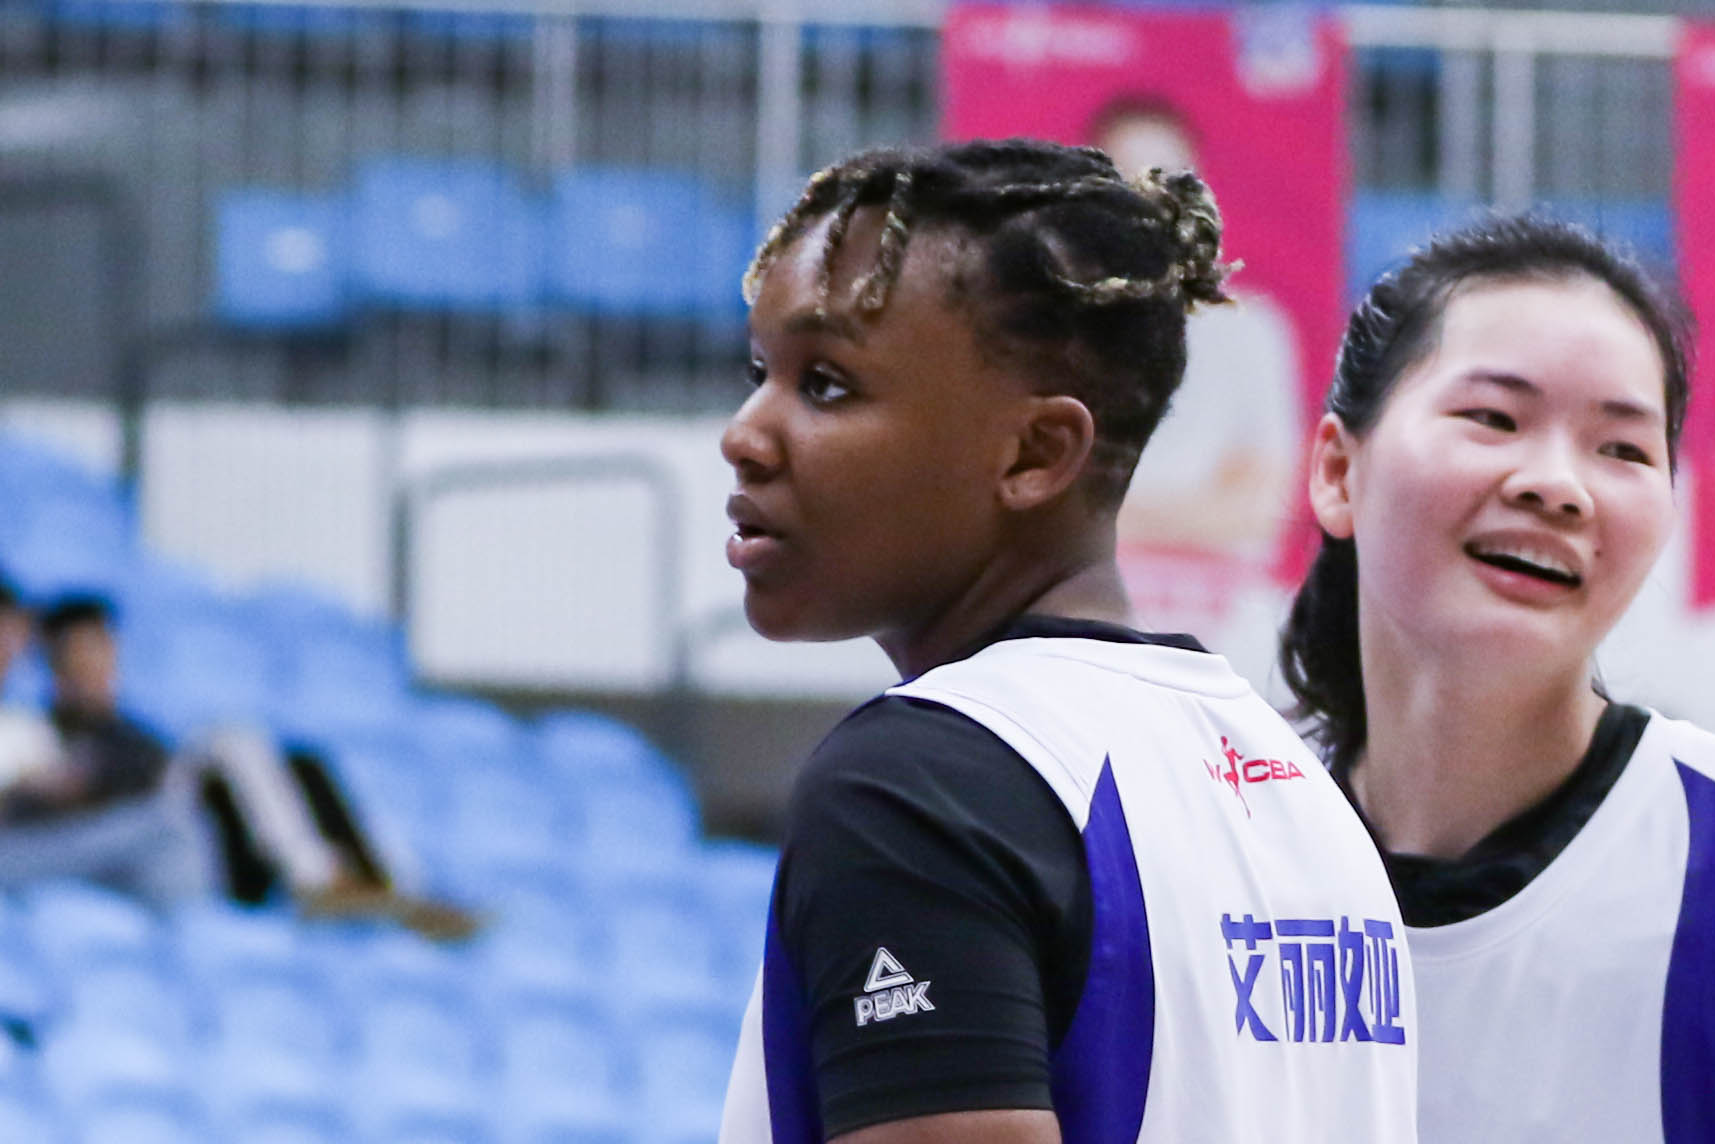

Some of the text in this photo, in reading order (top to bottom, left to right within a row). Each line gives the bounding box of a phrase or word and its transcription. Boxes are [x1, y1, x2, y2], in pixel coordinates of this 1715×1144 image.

[854, 981, 936, 1026] PEAK
[1221, 913, 1406, 1045] 艾丽娅
